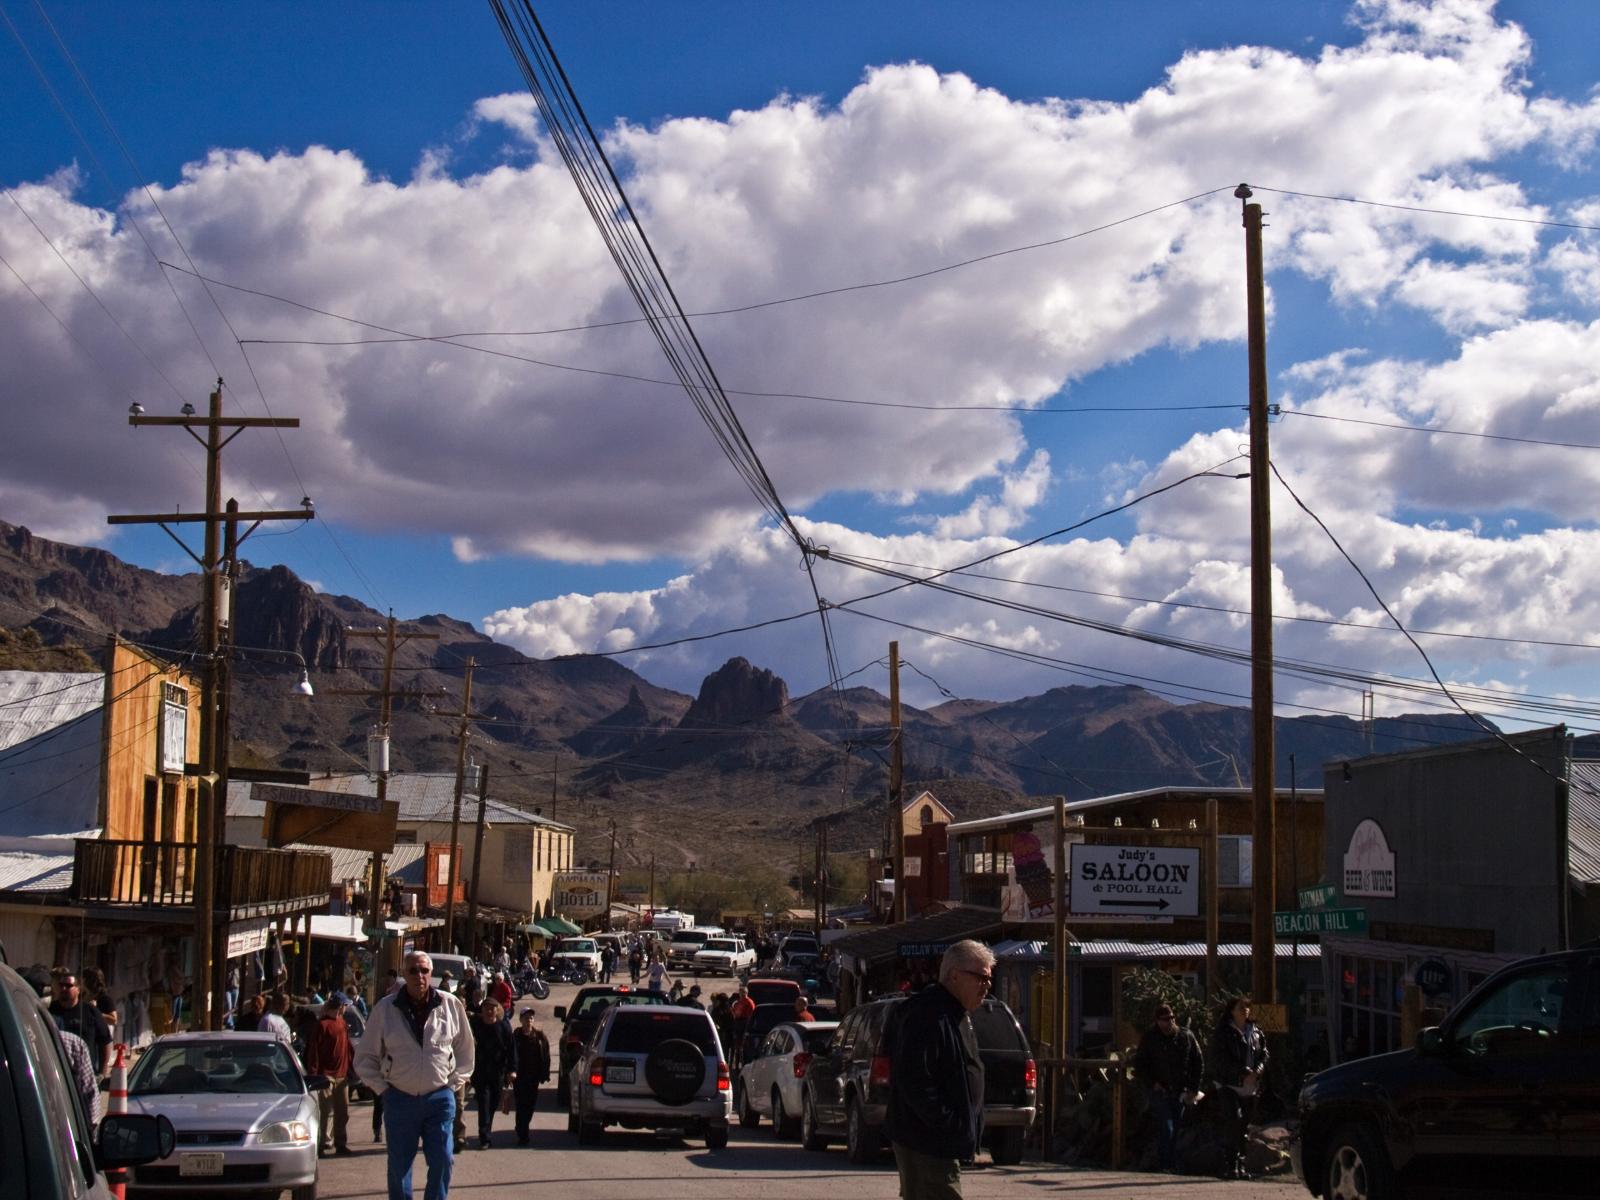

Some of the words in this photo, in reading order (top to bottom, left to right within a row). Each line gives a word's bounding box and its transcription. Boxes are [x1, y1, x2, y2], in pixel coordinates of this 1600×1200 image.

[321, 793, 379, 811] JACKETS
[1118, 849, 1155, 862] Judy's
[1081, 862, 1190, 883] SALOON
[1346, 870, 1362, 890] BEER
[1371, 870, 1393, 892] WINE
[560, 892, 602, 906] HOTEL
[1107, 884, 1143, 893] POOL
[1146, 885, 1183, 895] HALL
[1299, 888, 1326, 909] OATMAN
[1275, 913, 1320, 933] BEACON
[1325, 912, 1349, 931] HILL
